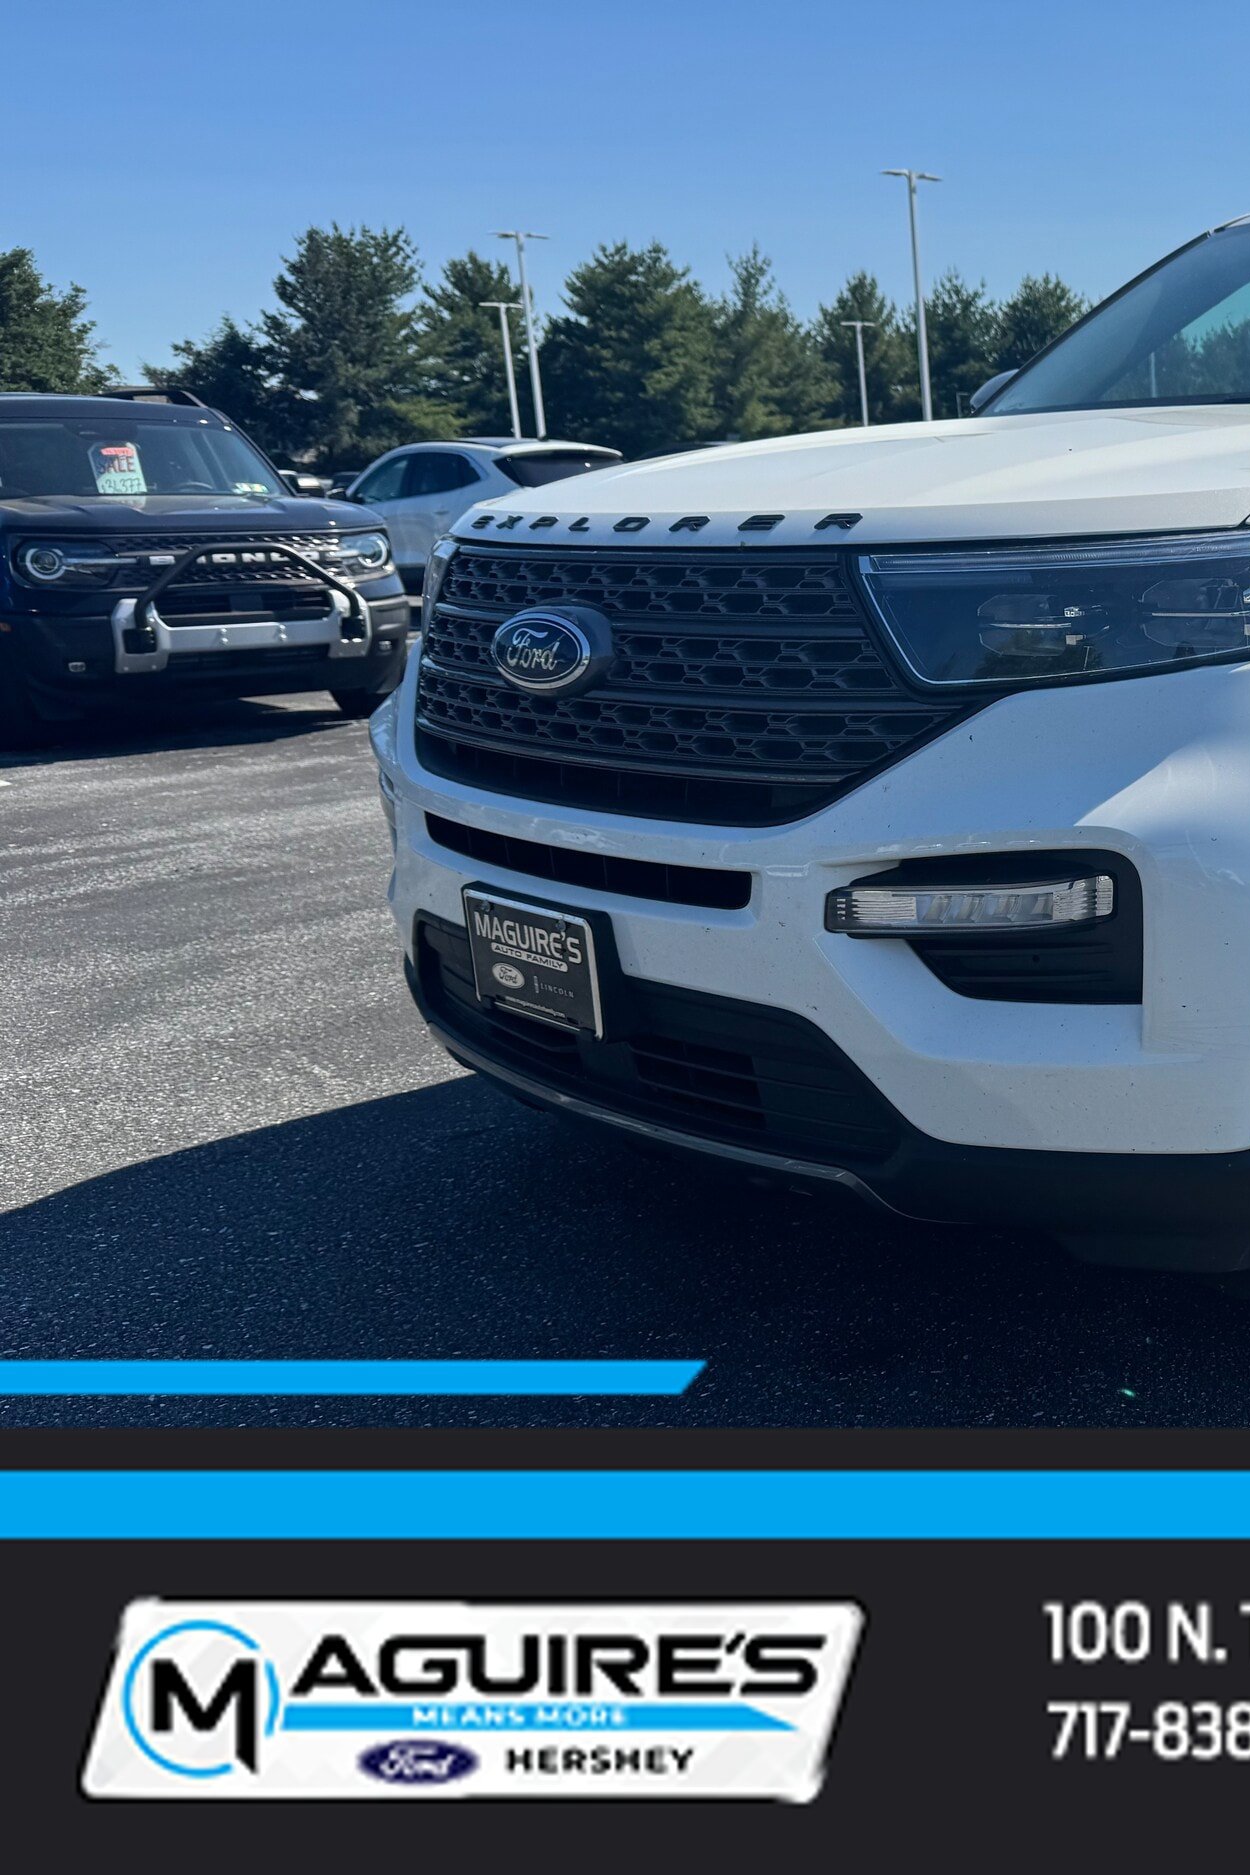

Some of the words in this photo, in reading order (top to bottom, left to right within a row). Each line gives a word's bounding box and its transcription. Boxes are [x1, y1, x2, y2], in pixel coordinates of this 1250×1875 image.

[96, 455, 136, 475] SALE
[470, 512, 864, 534] EXPLORER
[506, 627, 563, 672] Ford
[473, 910, 583, 965] MAGUIRE'S
[494, 944, 522, 959] AUTO
[526, 953, 564, 971] FAMILY
[498, 964, 520, 985] Ford
[540, 982, 575, 998] LINCOLN
